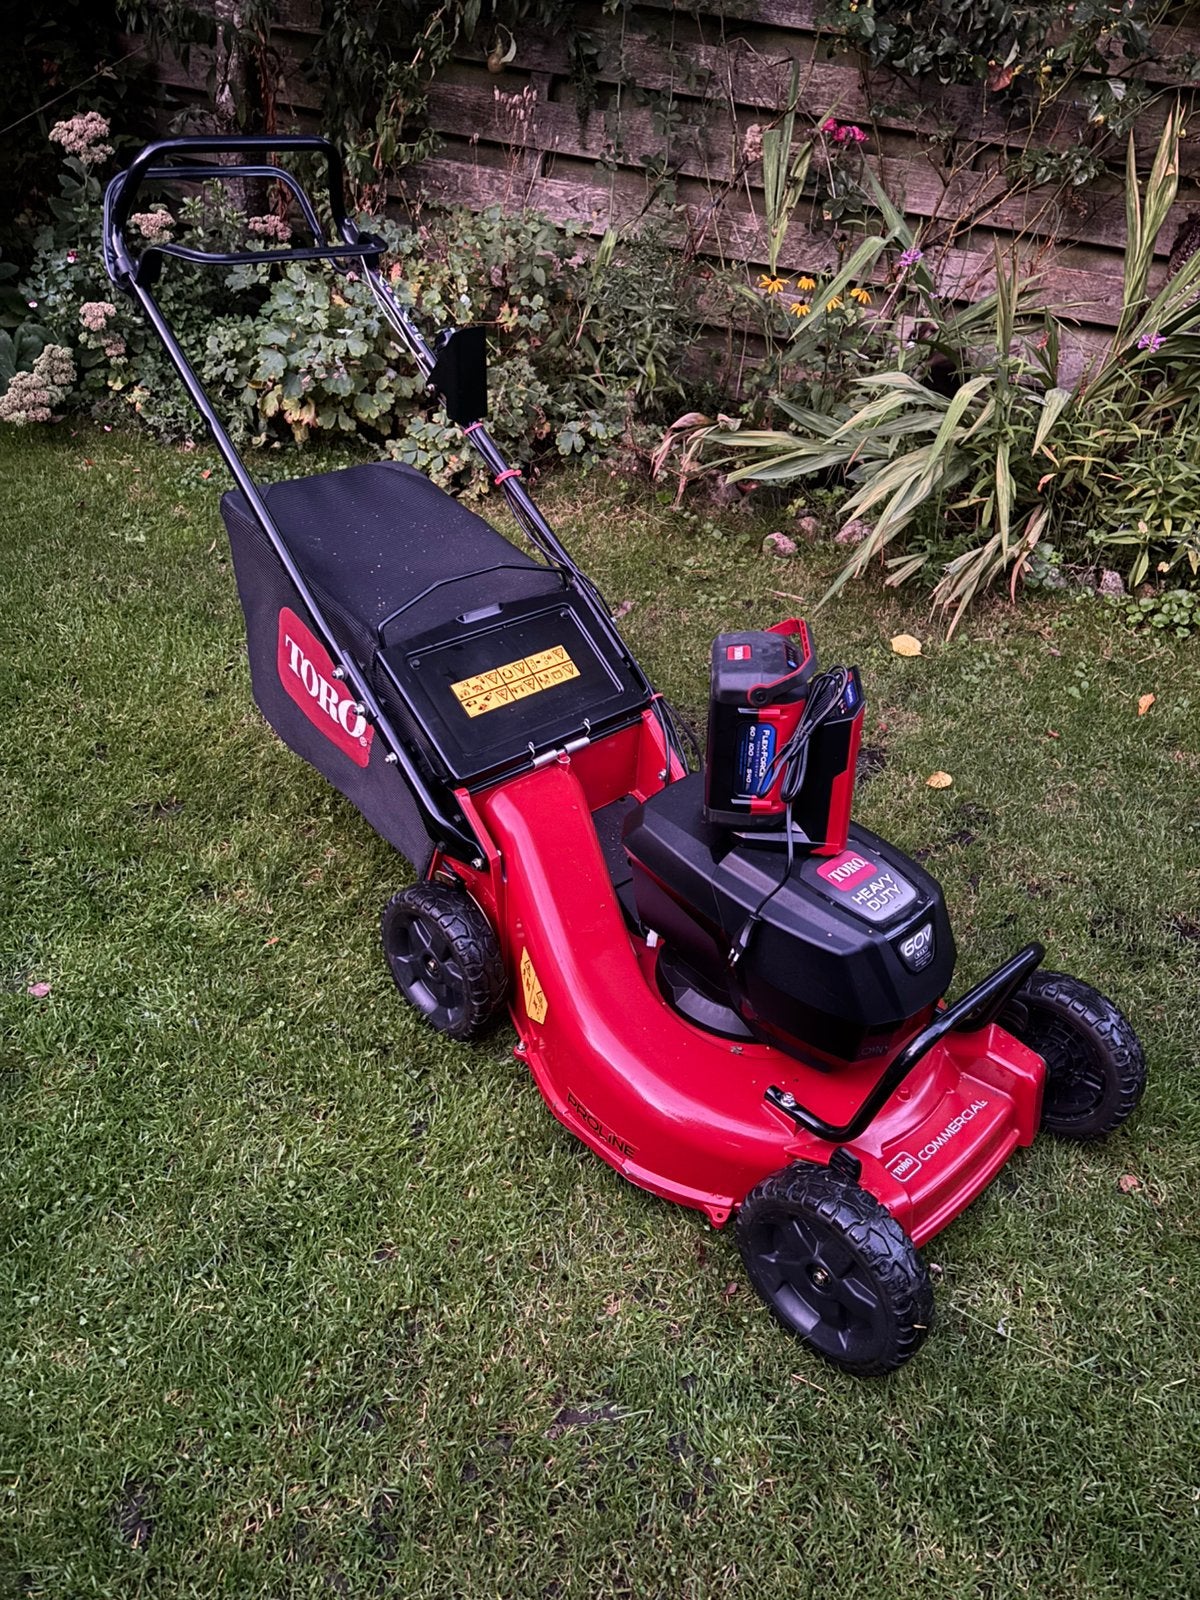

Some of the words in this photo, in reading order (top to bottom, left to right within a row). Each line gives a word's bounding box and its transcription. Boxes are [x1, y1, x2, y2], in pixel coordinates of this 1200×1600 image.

[284, 633, 367, 738] TORO
[749, 725, 756, 737] 60
[827, 857, 866, 883] TORO
[851, 873, 894, 905] HEAVY
[866, 883, 902, 911] DUTY
[904, 927, 931, 957] 60V
[567, 1092, 635, 1160] PROLINE
[892, 1157, 914, 1176] TORO
[918, 1100, 988, 1161] COMMERCIAL
